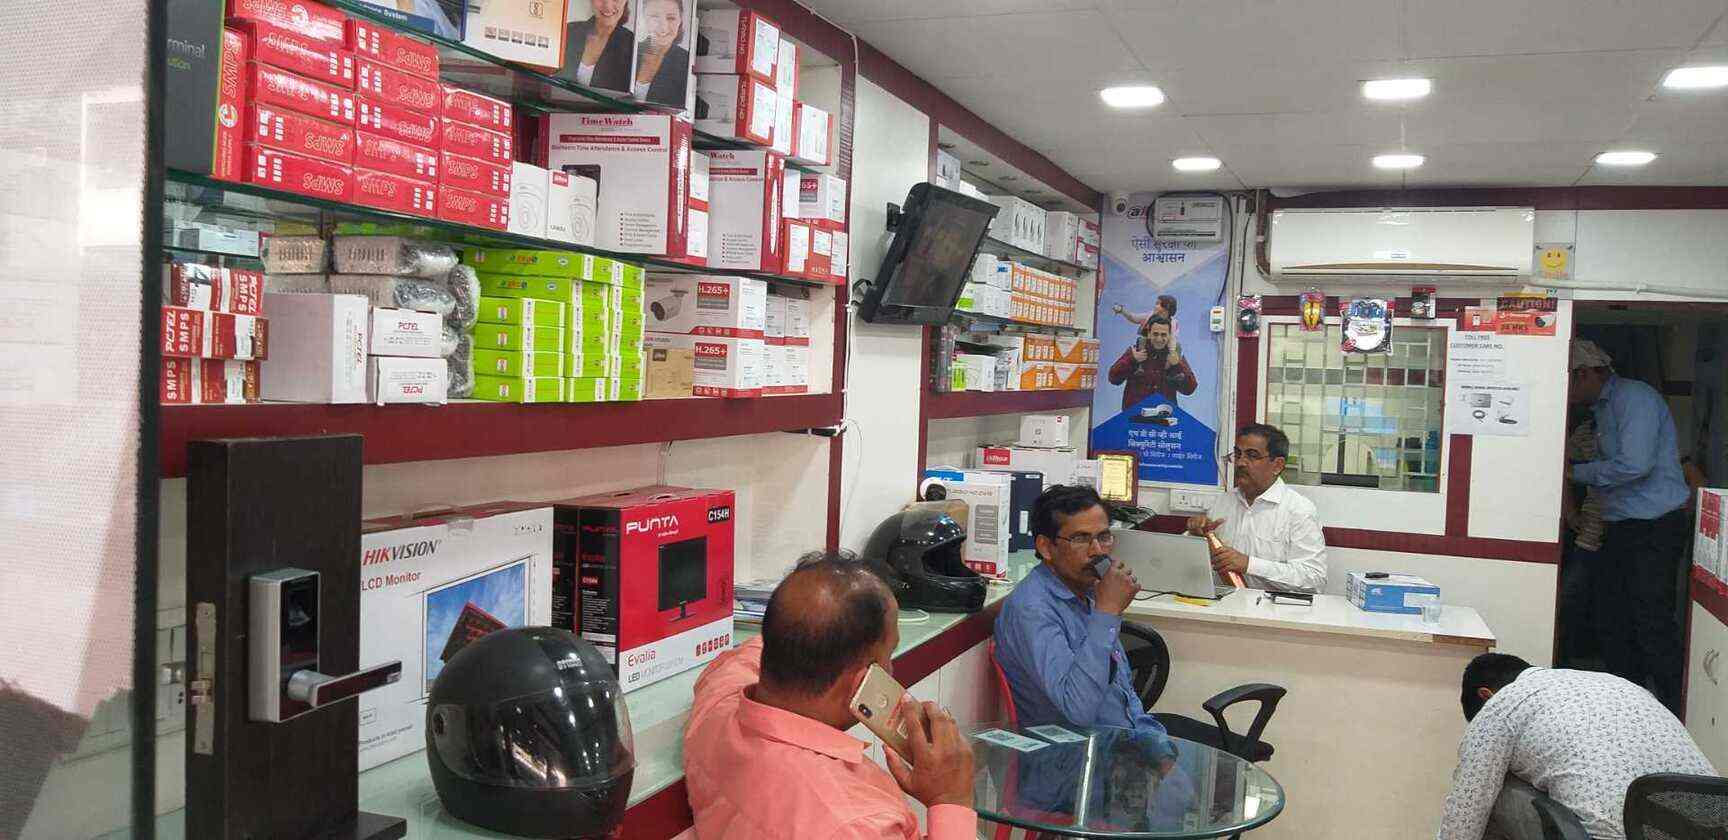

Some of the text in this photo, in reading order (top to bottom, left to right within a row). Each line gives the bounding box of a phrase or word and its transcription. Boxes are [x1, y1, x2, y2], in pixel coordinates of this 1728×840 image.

[303, 172, 344, 195] SMPS
[238, 275, 248, 312] SMPS
[249, 275, 258, 313] PCTEL
[699, 285, 729, 295] H.265+
[179, 312, 190, 353] SMPS
[399, 321, 419, 330] PCTEL
[696, 345, 727, 355] H.265+
[167, 361, 177, 400] SMPS
[362, 541, 437, 566] HIKVISION
[361, 571, 421, 591] LCD Monitor
[628, 671, 640, 683] LED
